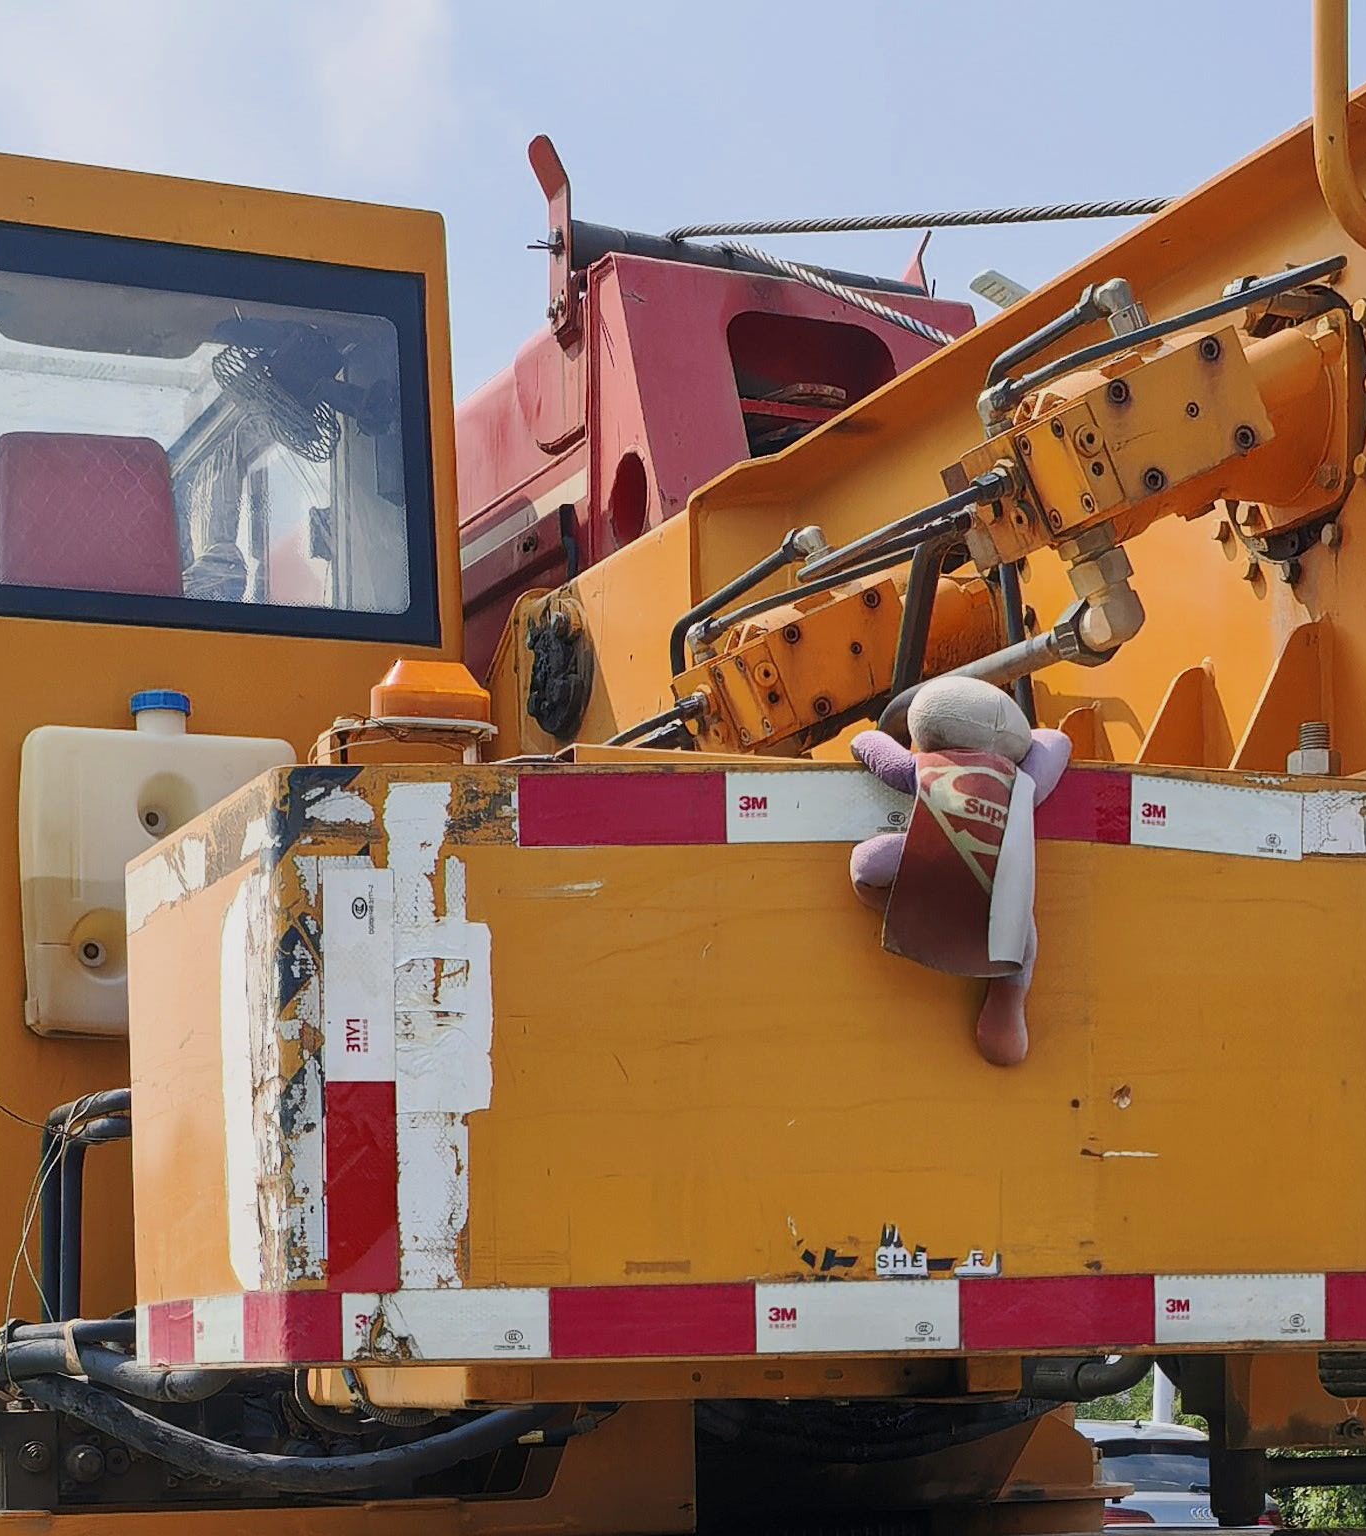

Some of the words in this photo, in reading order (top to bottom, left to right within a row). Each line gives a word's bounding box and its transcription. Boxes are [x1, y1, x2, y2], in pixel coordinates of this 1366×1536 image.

[739, 796, 768, 811] 3M
[1141, 802, 1167, 819] 3M
[1165, 1298, 1190, 1313] 3M
[768, 1306, 797, 1321] 3M
